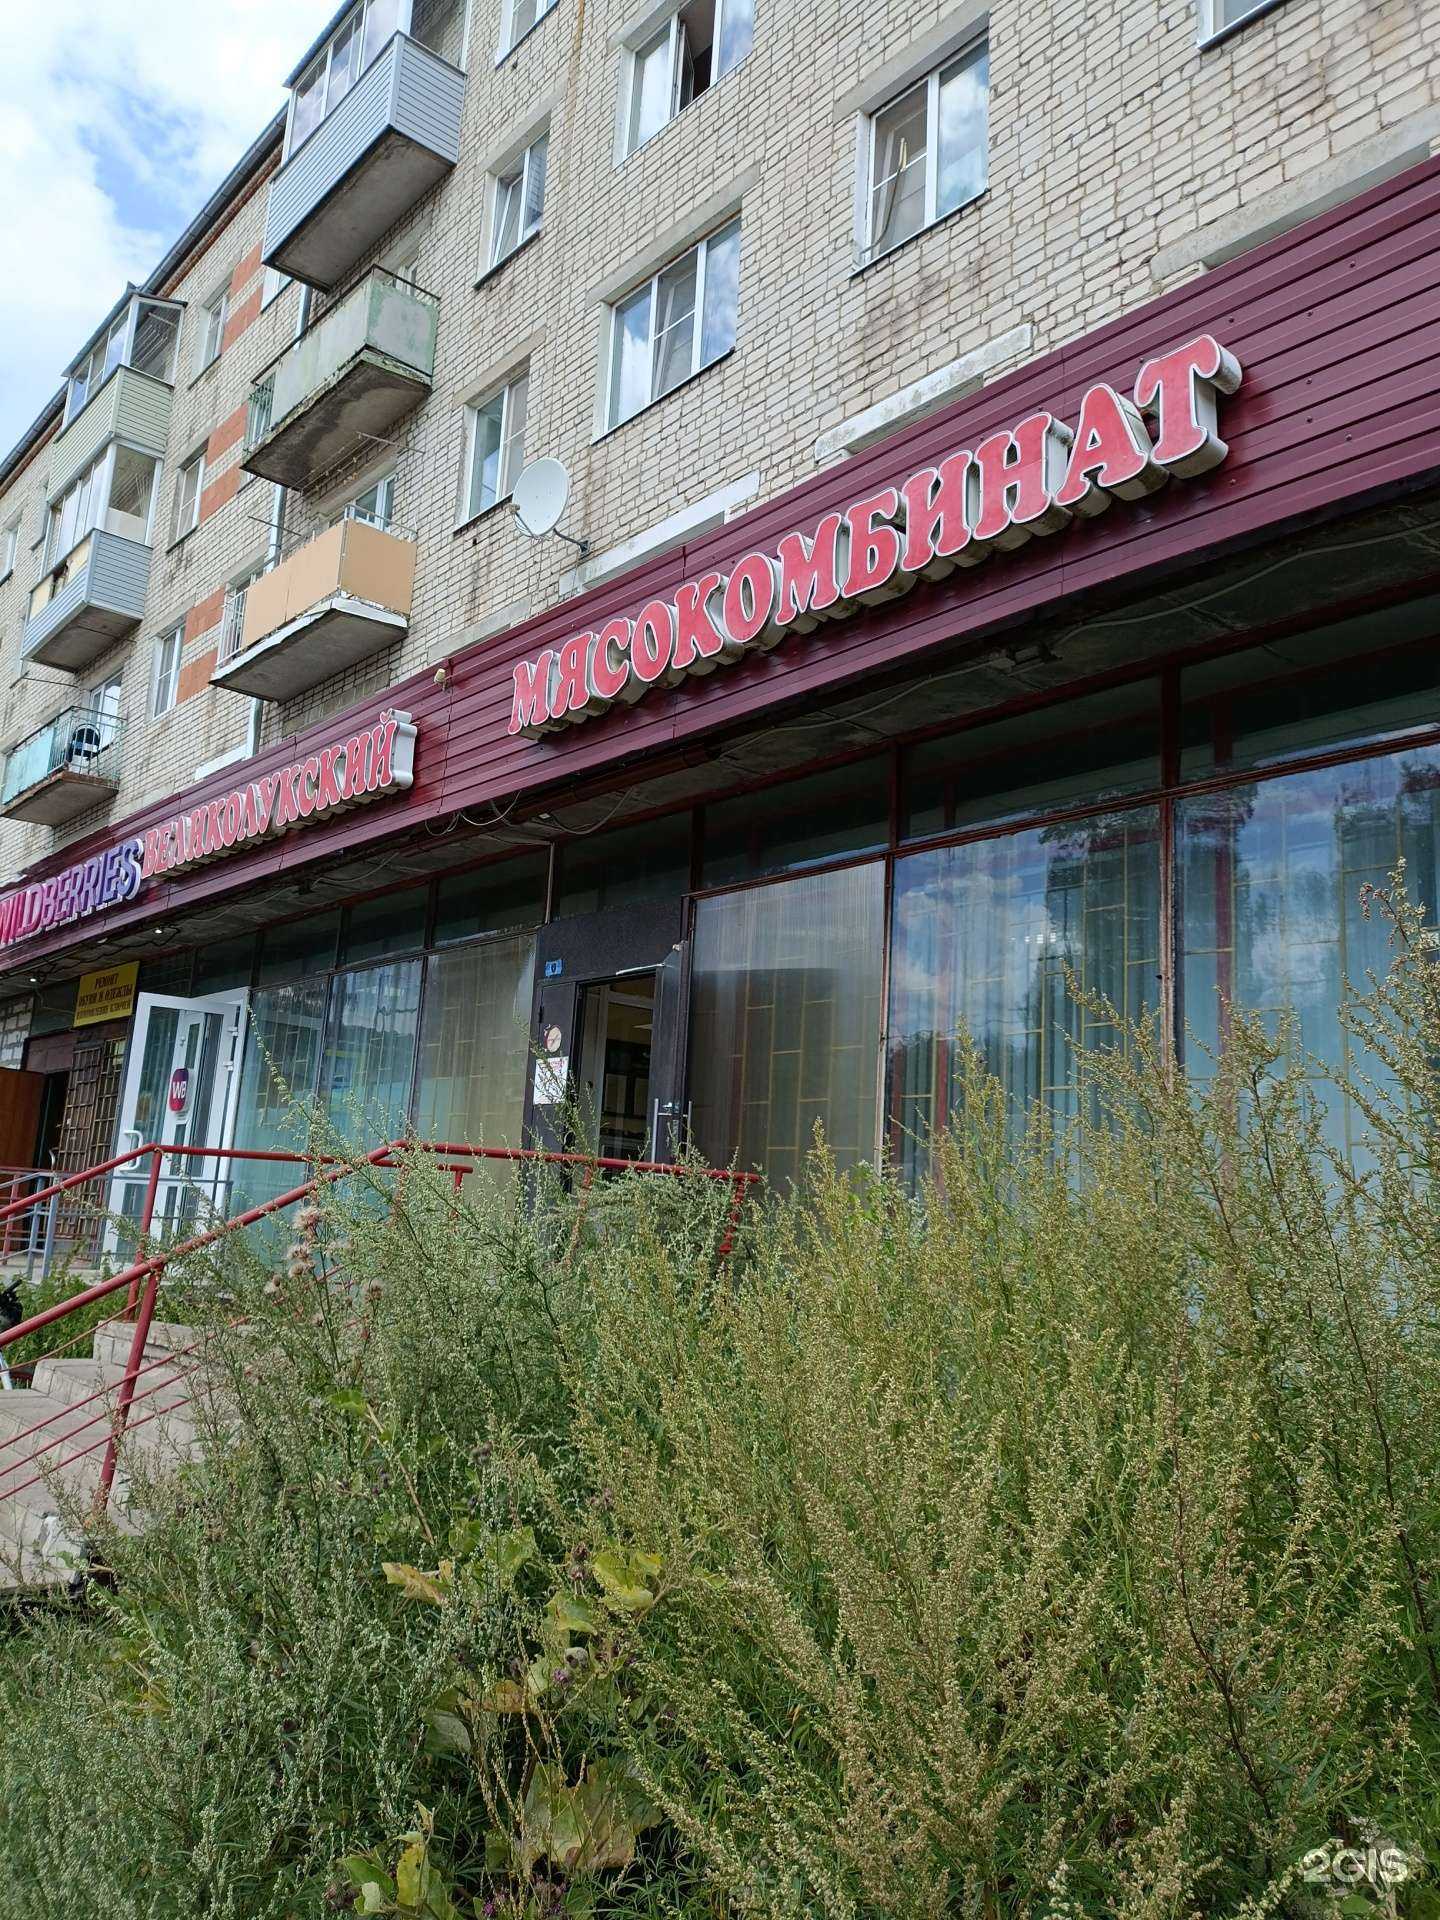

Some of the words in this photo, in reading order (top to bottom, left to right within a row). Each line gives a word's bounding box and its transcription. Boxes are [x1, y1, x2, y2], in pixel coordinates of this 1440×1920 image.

[507, 334, 1232, 738] МЯСОКОМБИНАТ
[141, 710, 402, 879] ВЕЛИКОЛУКСКИЙ
[0, 838, 144, 945] WILDBERRIES
[172, 1080, 187, 1099] WB
